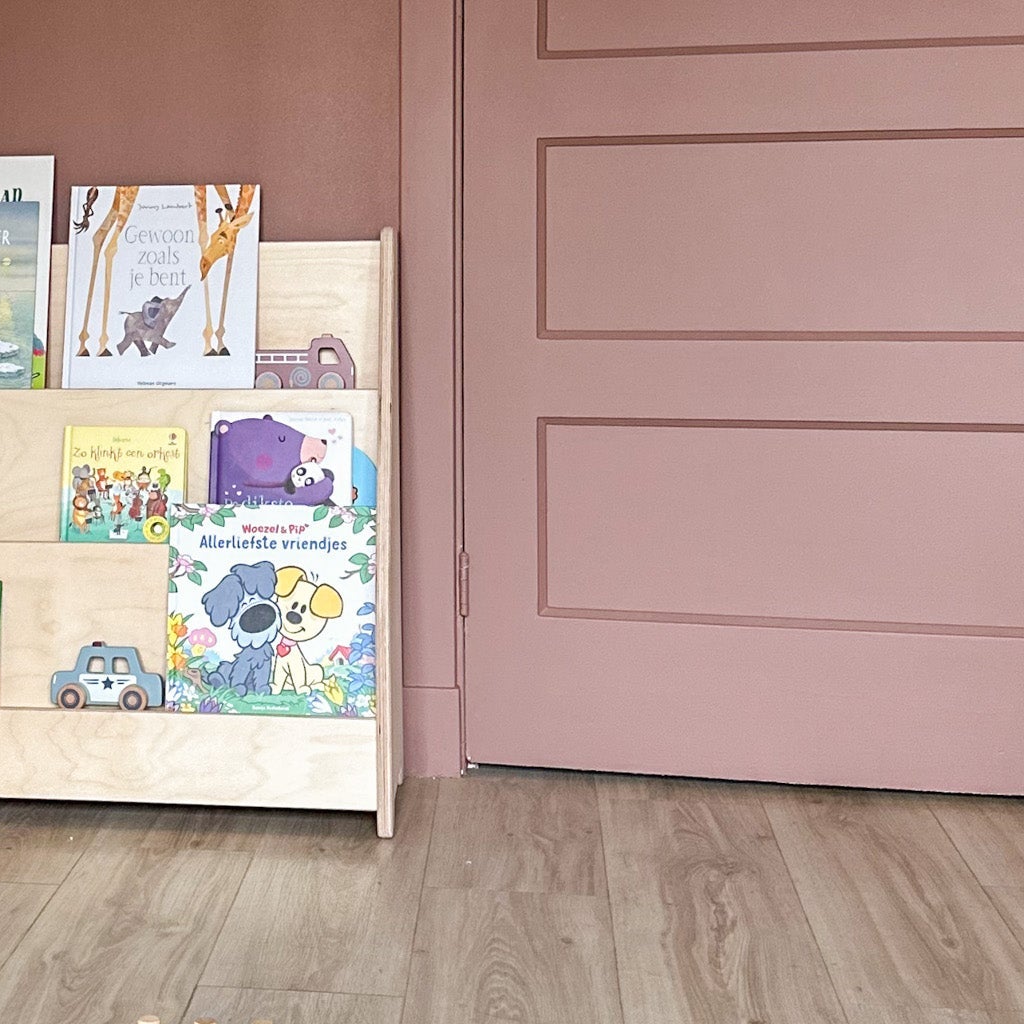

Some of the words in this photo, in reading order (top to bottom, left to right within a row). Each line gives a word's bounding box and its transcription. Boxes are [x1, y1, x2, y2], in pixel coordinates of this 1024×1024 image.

[125, 225, 194, 244] Gewoon
[138, 246, 180, 265] zoals
[129, 268, 144, 291] je
[150, 267, 186, 286] bent
[73, 447, 87, 458] Zo
[90, 445, 123, 462] klinkt
[126, 449, 144, 458] een
[242, 524, 279, 534] Woezel
[200, 535, 277, 549] Allerliefste
[282, 537, 347, 553] vriendjes
